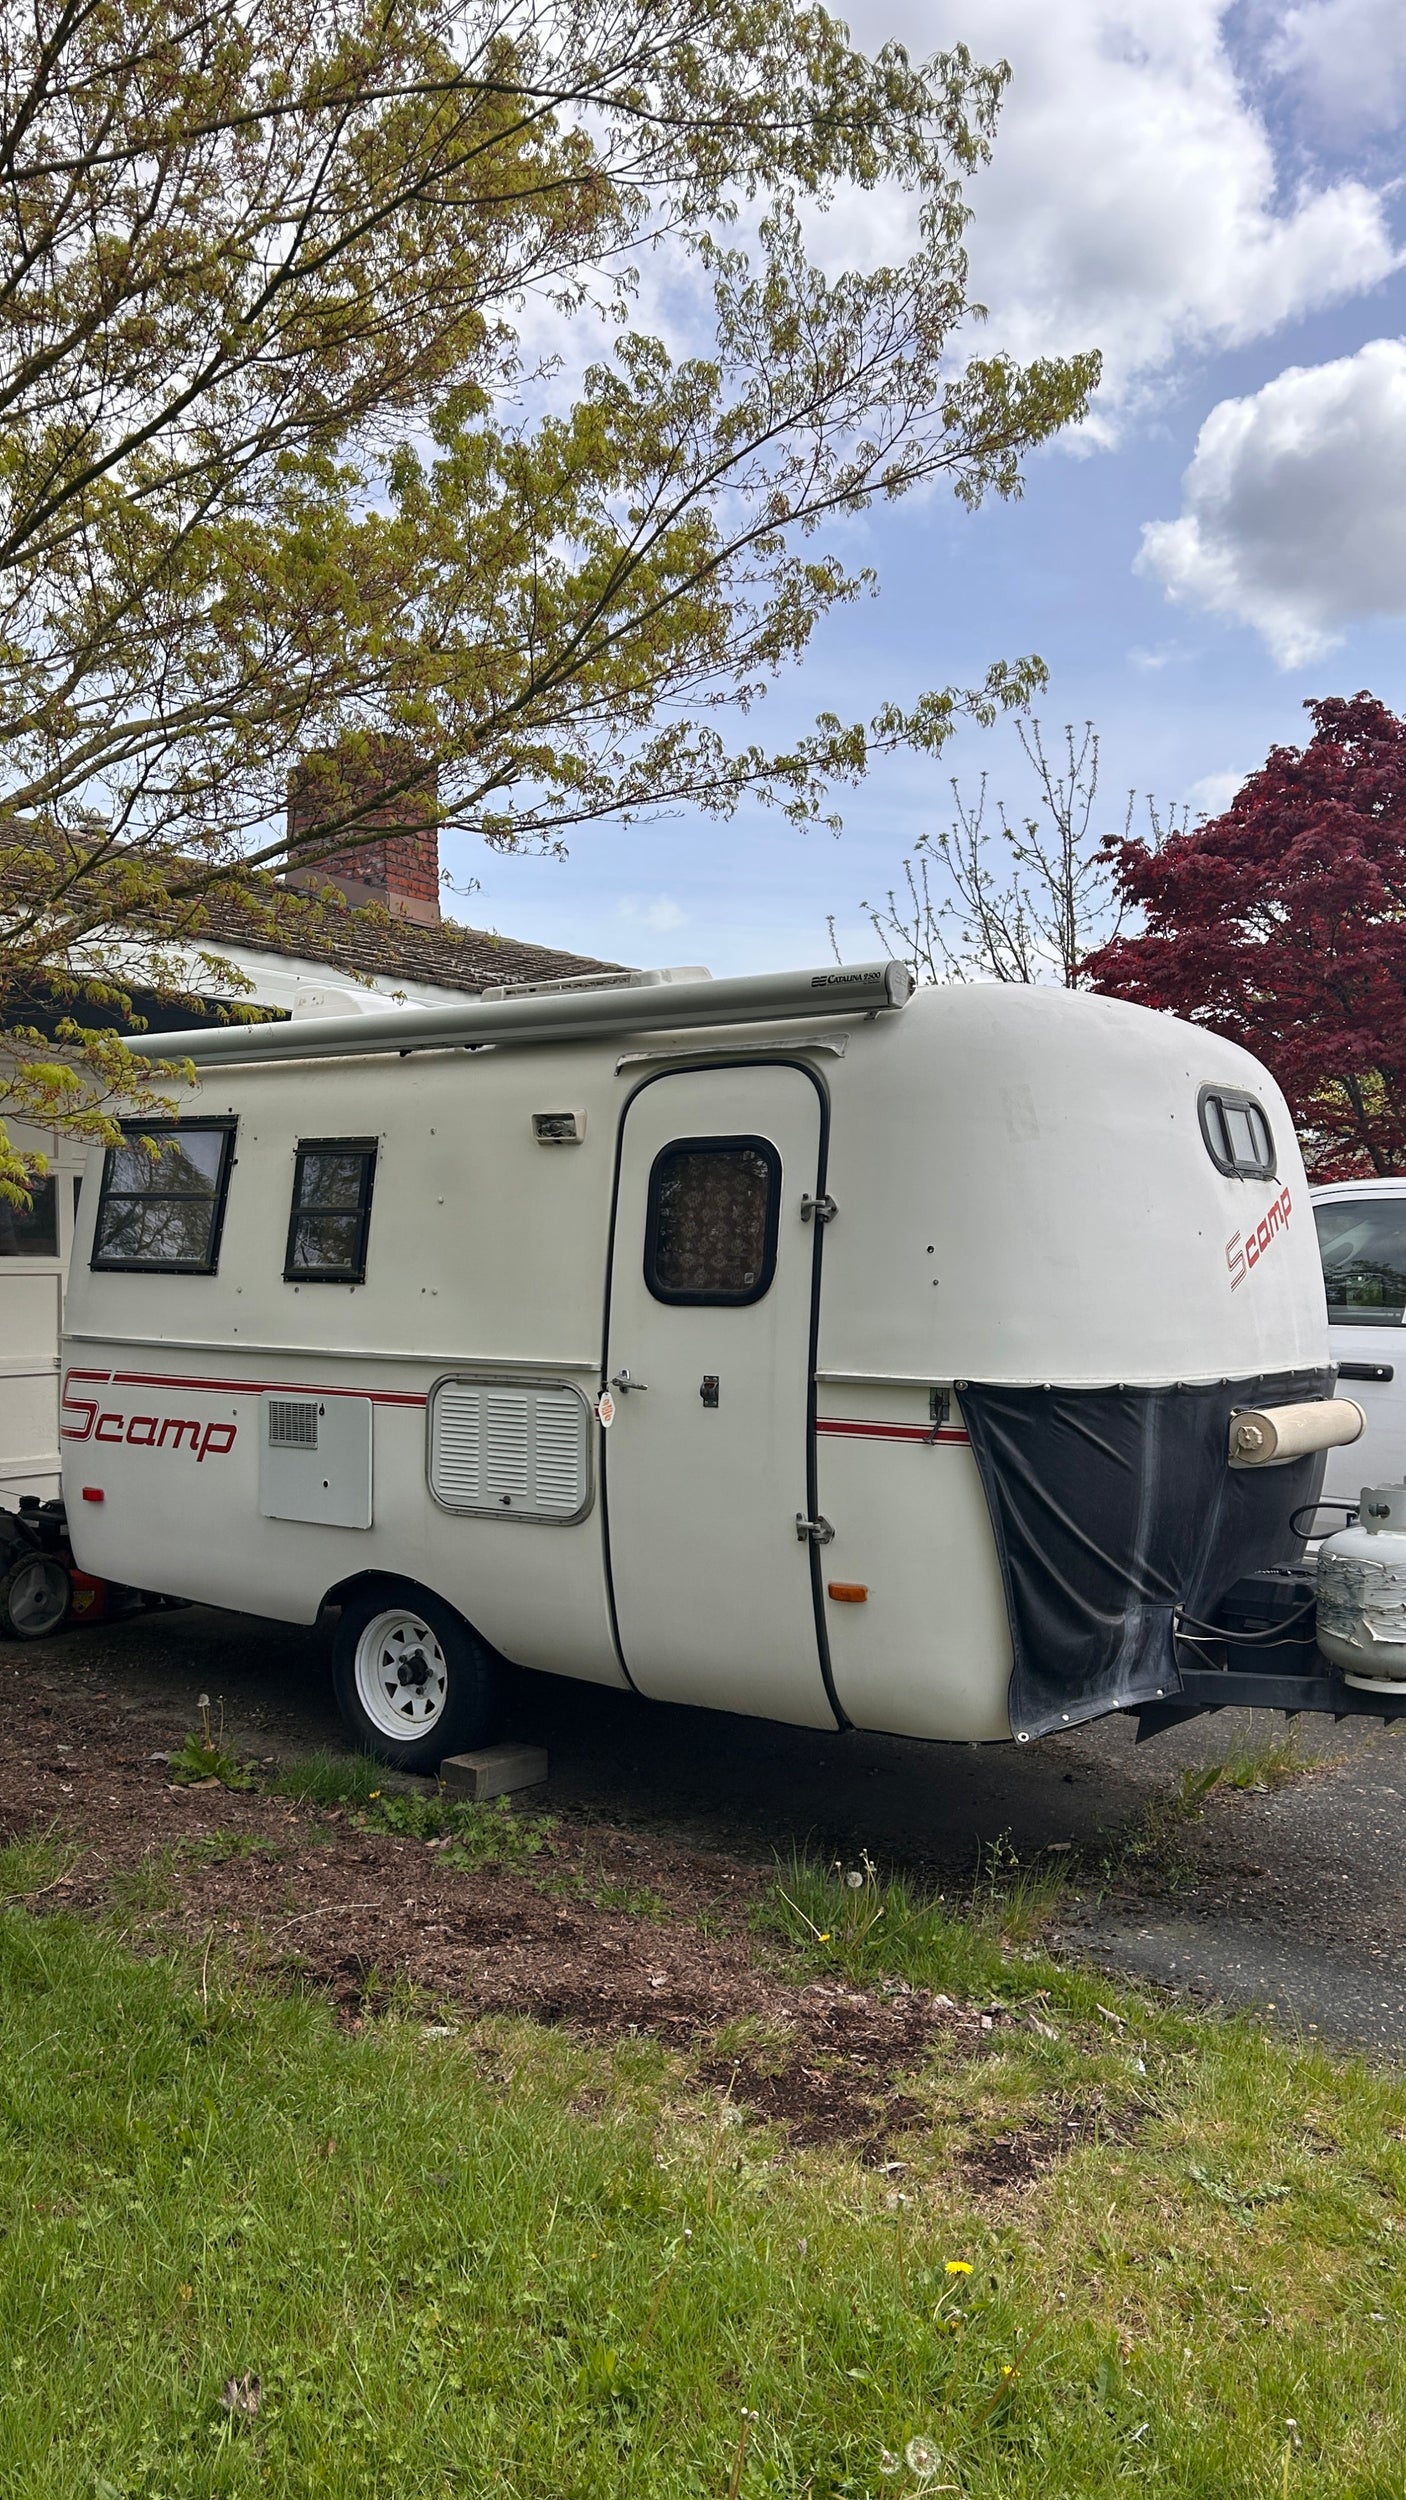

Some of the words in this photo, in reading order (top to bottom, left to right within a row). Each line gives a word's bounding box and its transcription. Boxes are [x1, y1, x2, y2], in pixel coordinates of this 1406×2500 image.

[828, 974, 862, 984] CATALINA
[1225, 1187, 1292, 1292] Scamp
[61, 1367, 237, 1463] Scamp
